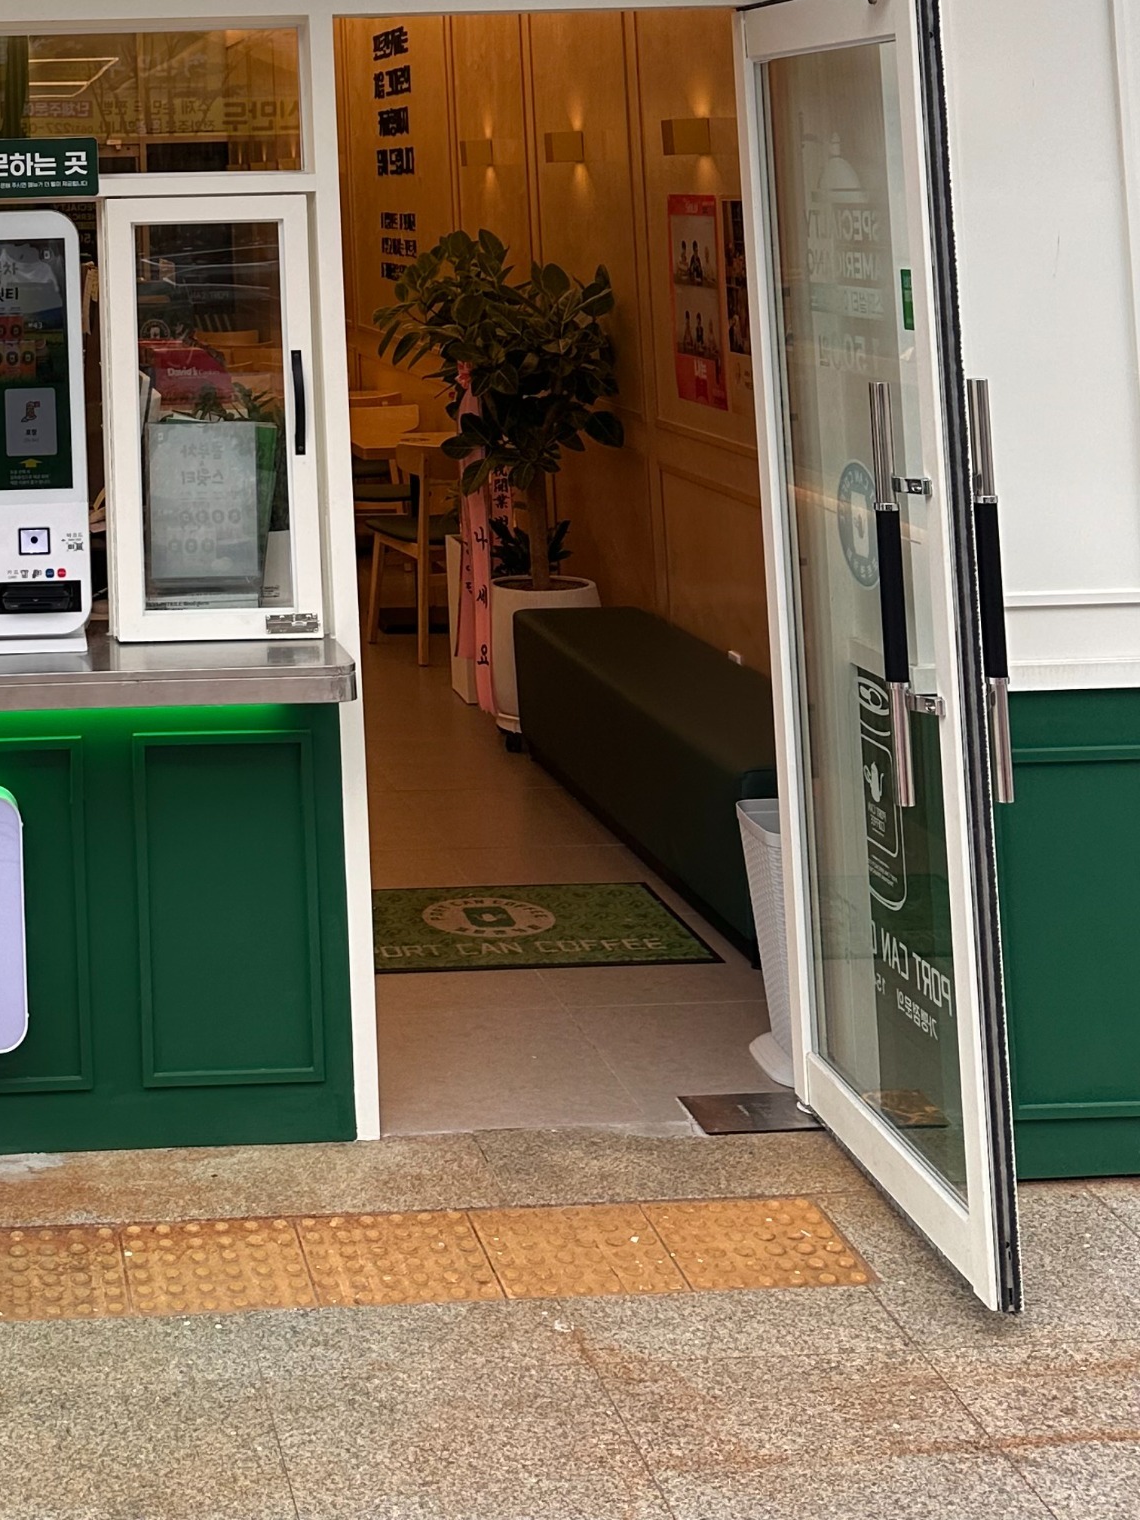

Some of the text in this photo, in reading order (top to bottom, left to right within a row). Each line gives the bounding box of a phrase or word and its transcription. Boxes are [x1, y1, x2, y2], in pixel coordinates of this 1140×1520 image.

[64, 151, 88, 175] 곳
[375, 937, 668, 960] ORT CAN COFFEE
